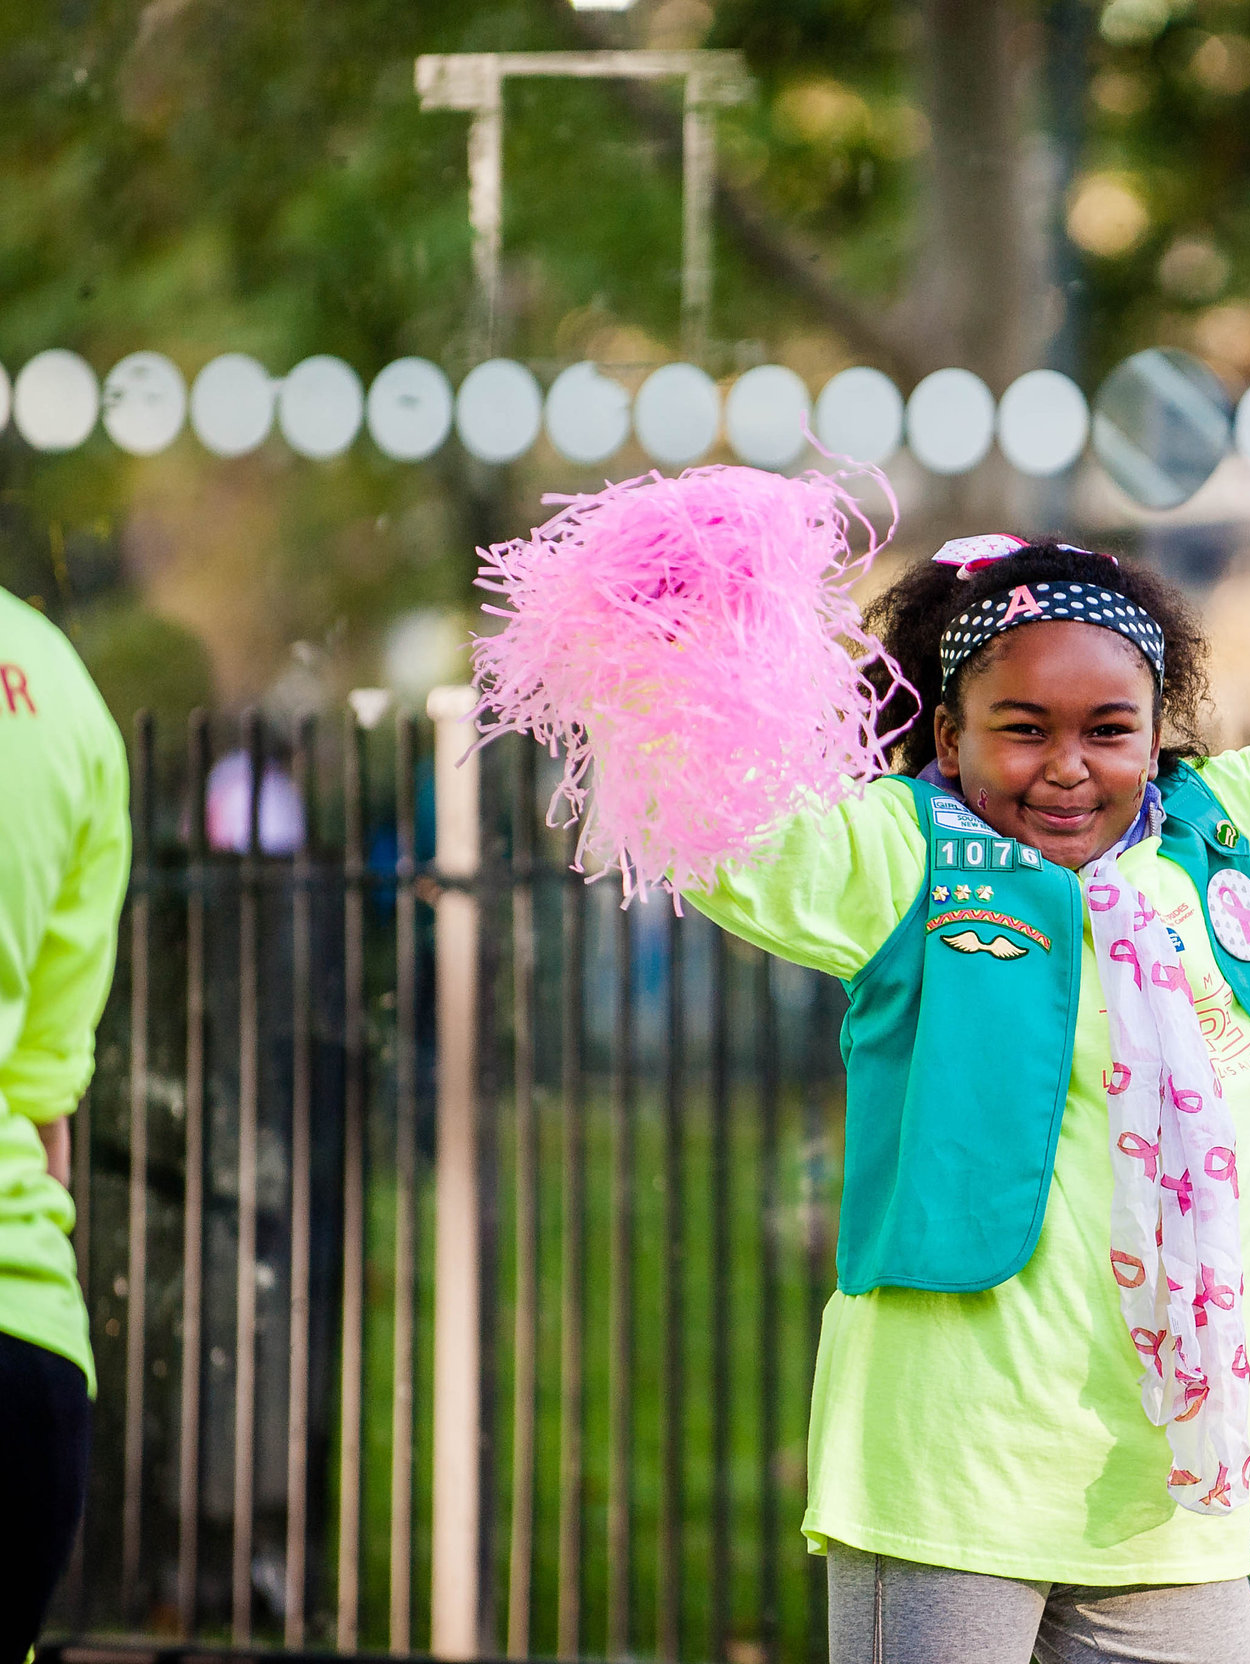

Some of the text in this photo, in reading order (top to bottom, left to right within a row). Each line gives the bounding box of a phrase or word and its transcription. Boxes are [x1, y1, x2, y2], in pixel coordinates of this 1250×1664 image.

[1004, 584, 1043, 624] A
[0, 662, 36, 714] R
[942, 841, 1039, 866] 1076
